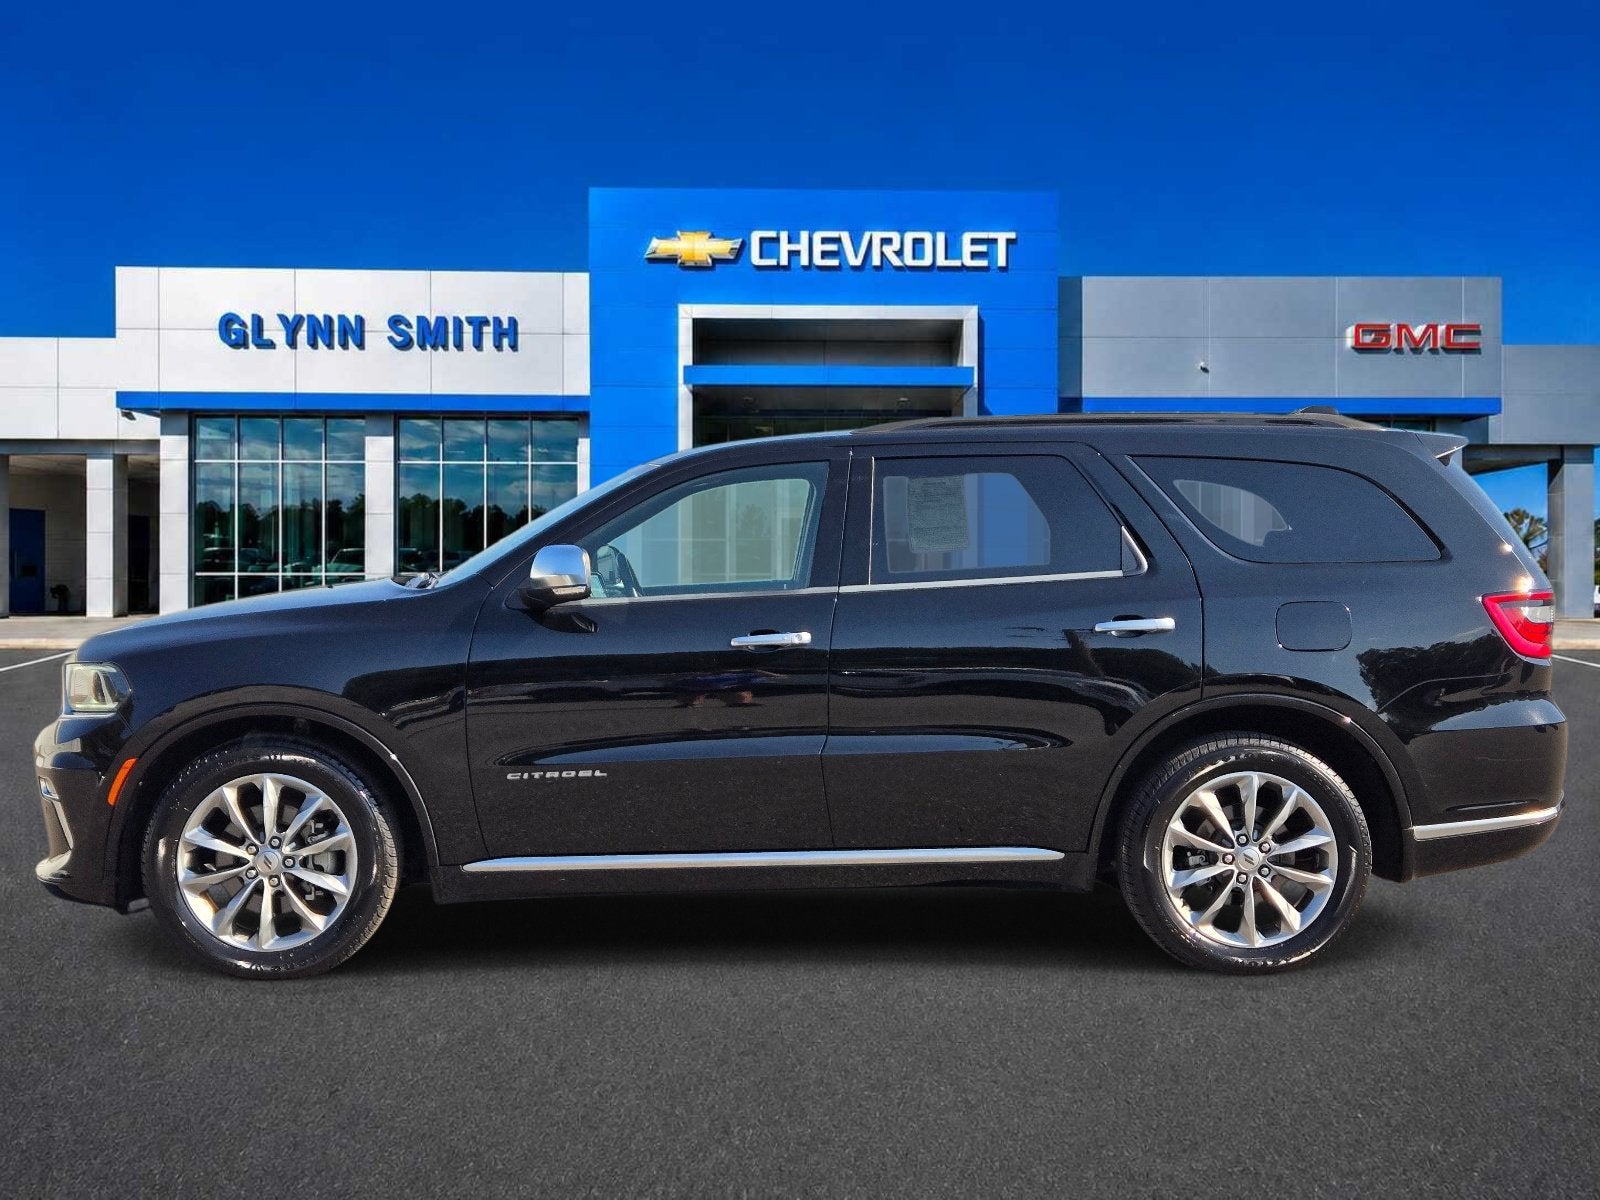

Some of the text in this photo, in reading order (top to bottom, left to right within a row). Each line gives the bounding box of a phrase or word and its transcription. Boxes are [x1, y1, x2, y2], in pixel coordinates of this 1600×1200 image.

[751, 231, 1017, 269] CHEVROLET
[218, 312, 519, 352] GLYNN SMITH
[1352, 323, 1482, 353] GMC
[506, 769, 608, 780] CITADEL
